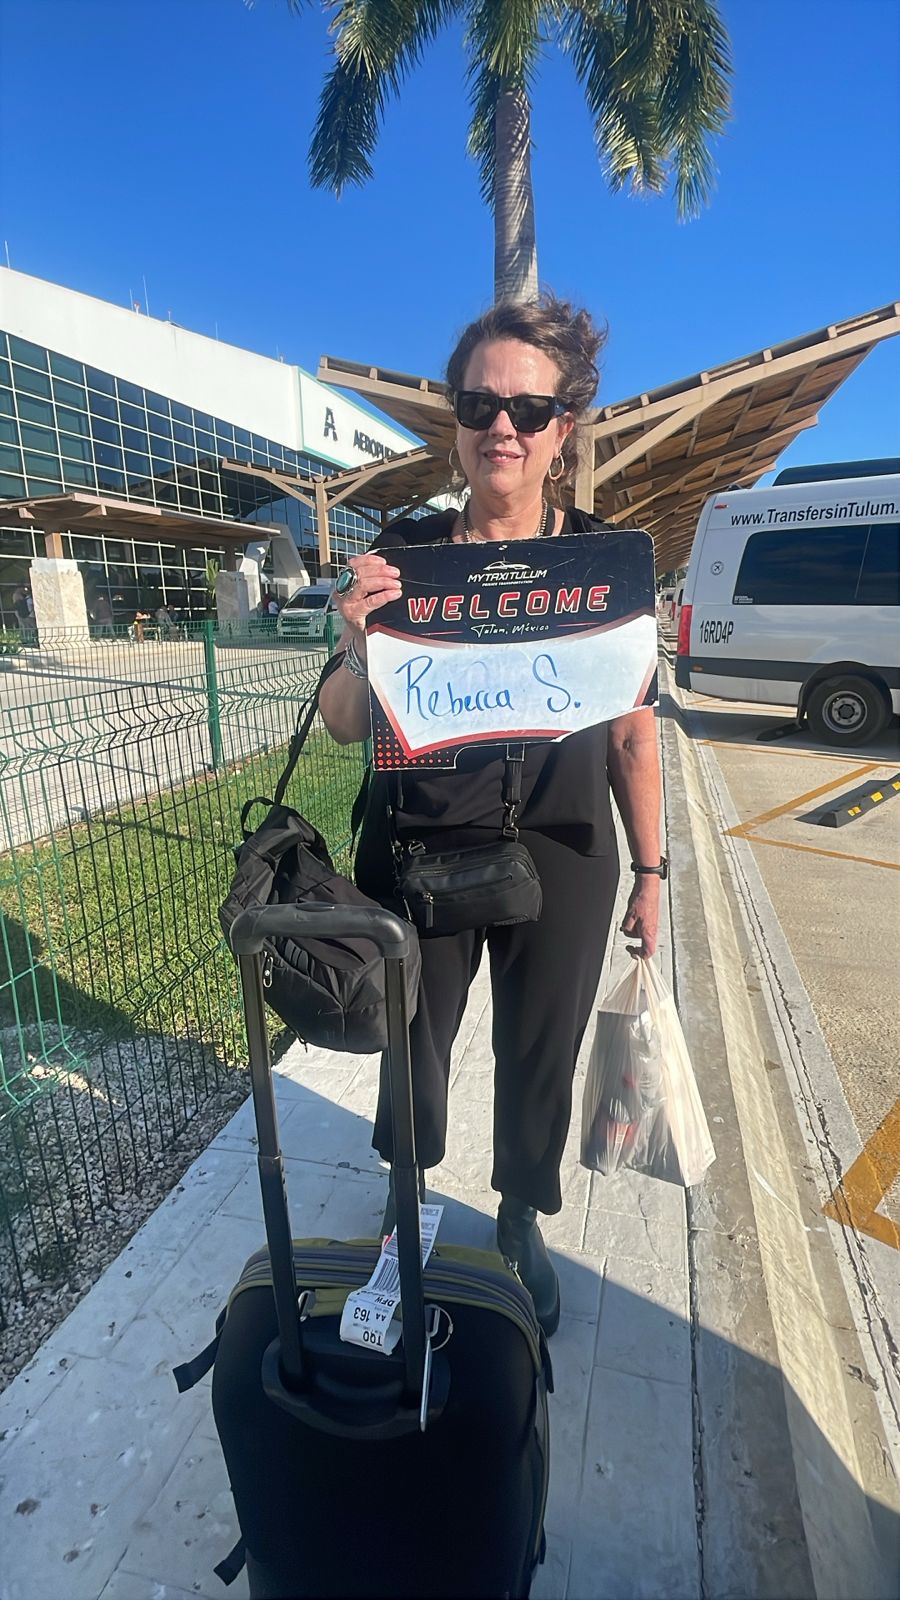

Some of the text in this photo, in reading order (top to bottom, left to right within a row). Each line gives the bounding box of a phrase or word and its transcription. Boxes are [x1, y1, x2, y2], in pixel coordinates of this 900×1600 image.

[730, 501, 899, 526] www.TransfersinTulum.
[467, 570, 547, 583] MYTAXITULUM
[408, 585, 611, 623] WELCOME
[700, 620, 734, 644] 16RD4P
[394, 654, 581, 720] Rebecca S.
[375, 1296, 395, 1307] DFW
[353, 1307, 370, 1323] 163
[375, 1313, 387, 1322] AA
[362, 1330, 383, 1347] TQO
